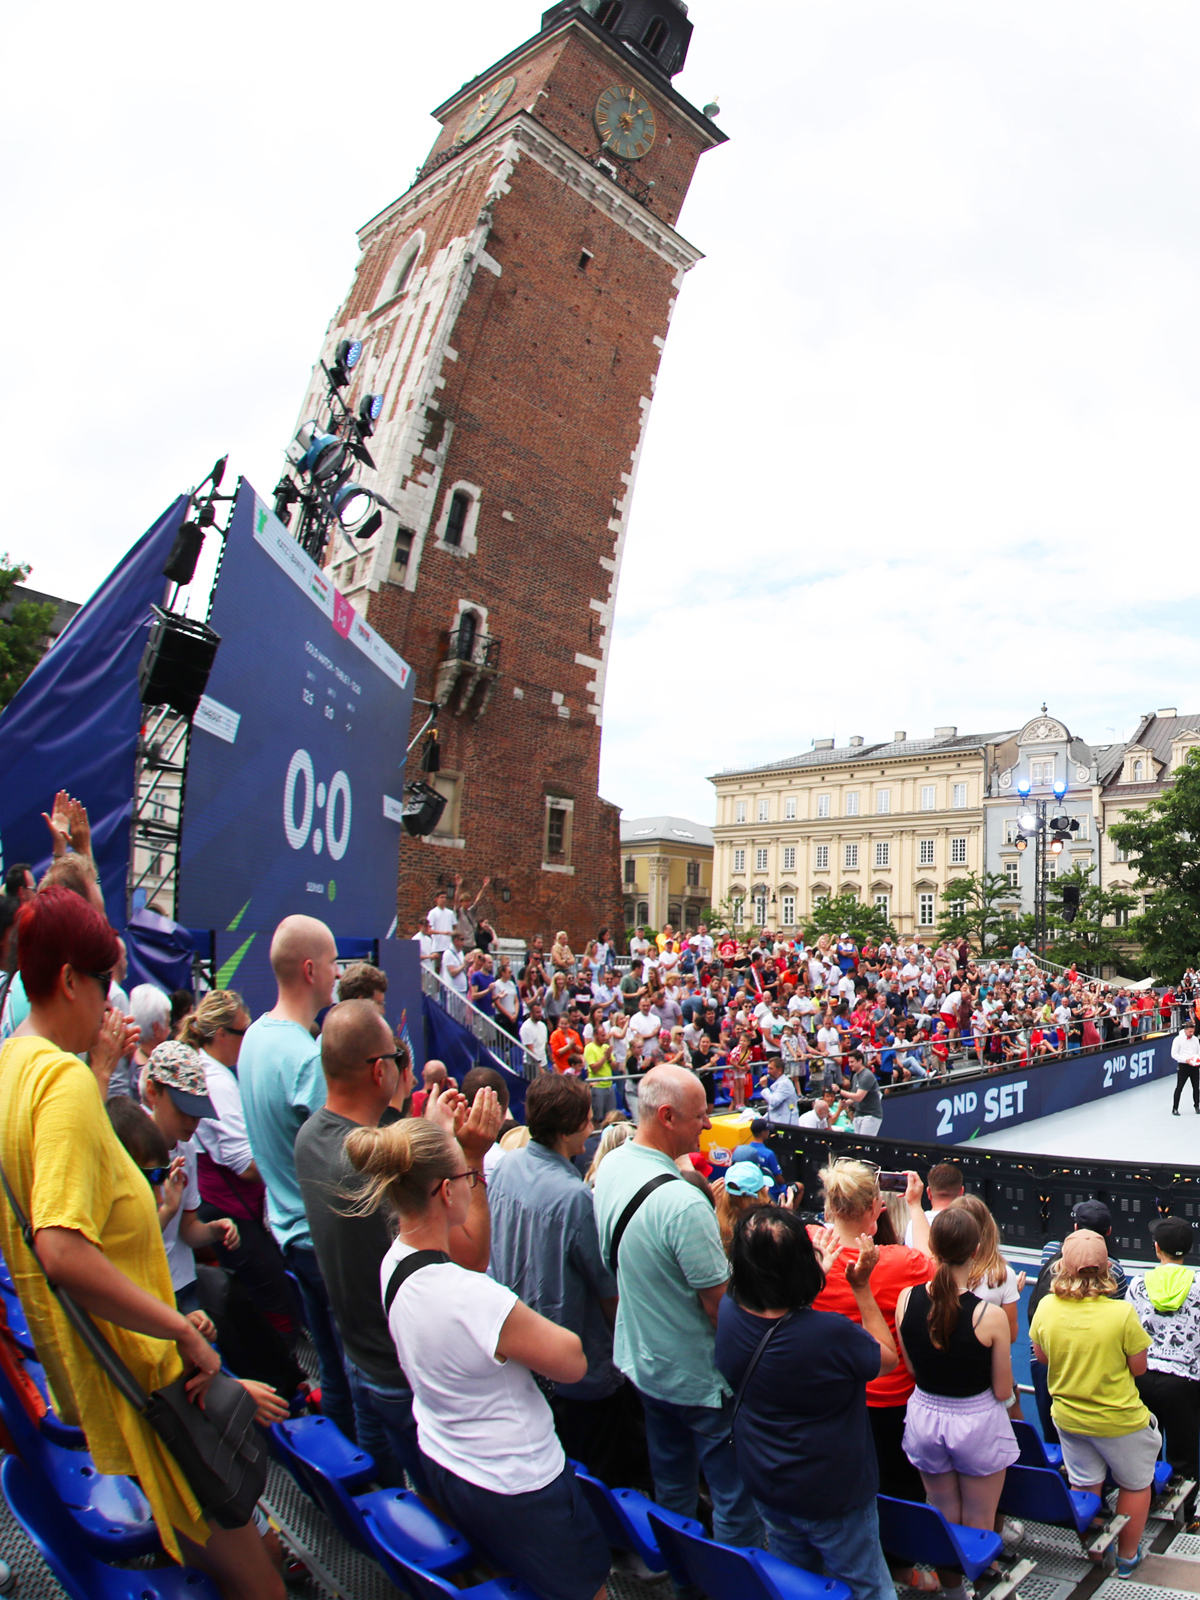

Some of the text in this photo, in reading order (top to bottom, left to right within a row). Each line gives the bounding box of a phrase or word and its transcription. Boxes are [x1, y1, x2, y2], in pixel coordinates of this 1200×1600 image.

[284, 748, 352, 861] 0:0
[1103, 1048, 1155, 1088] 2ND SET
[936, 1080, 1028, 1137] 2ND SET
